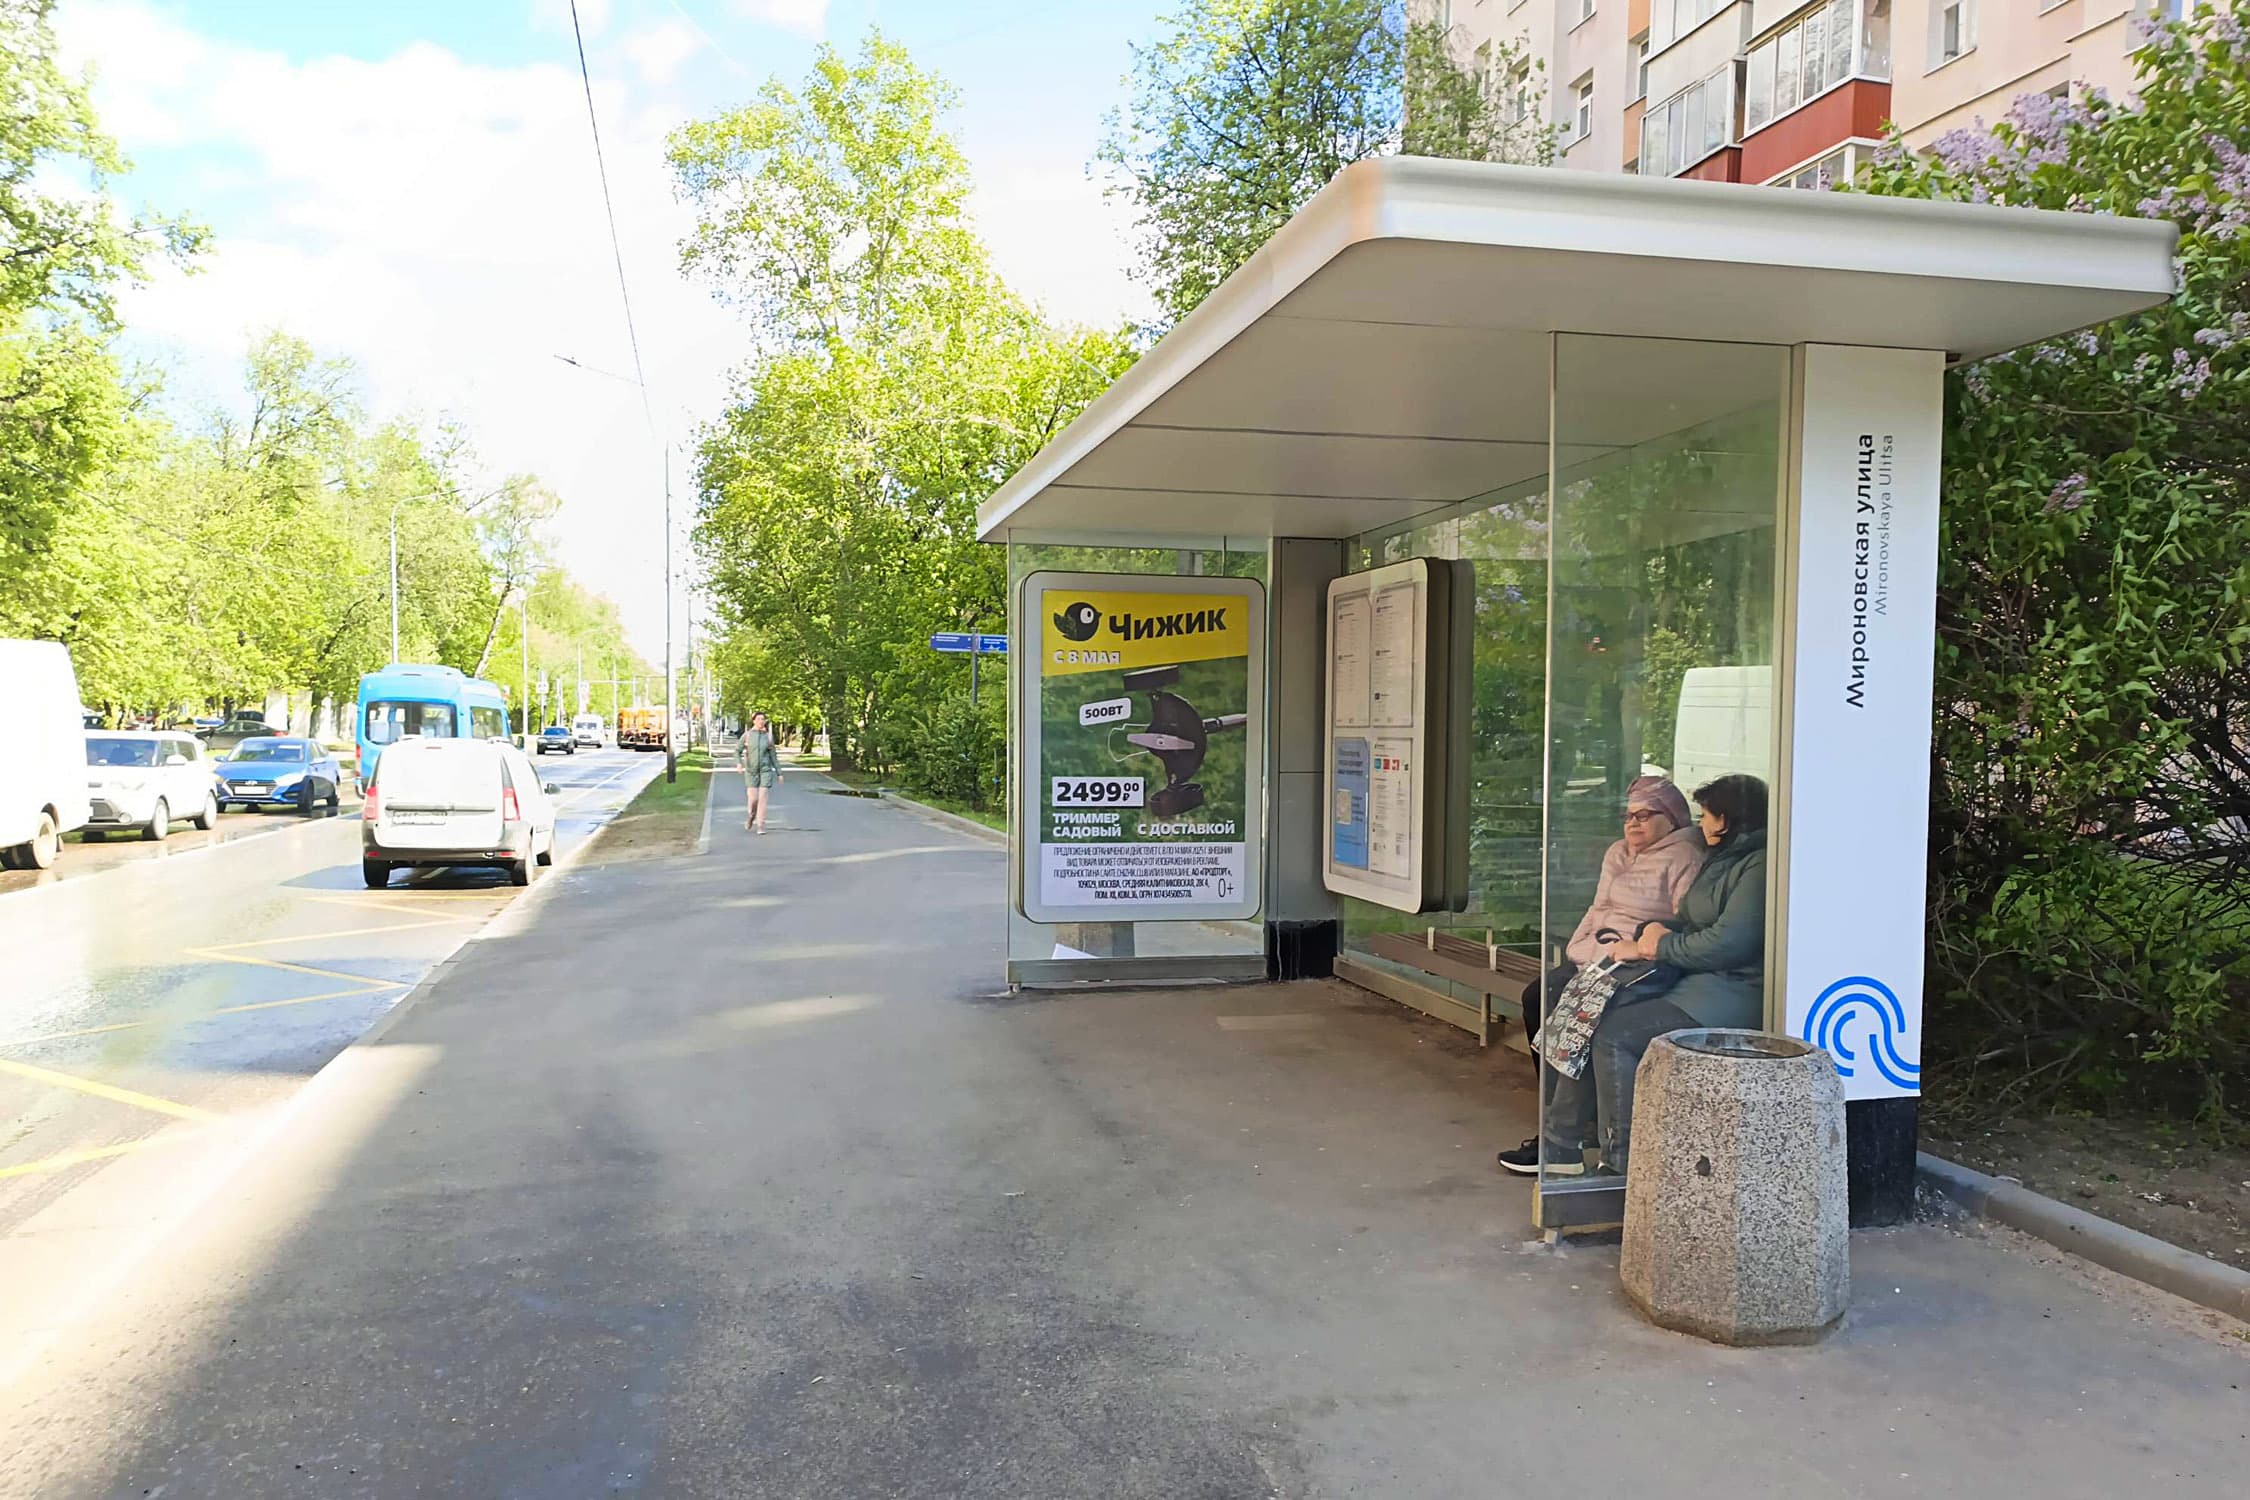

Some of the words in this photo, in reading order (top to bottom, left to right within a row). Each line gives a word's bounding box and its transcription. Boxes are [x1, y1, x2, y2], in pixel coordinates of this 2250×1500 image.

[1878, 435, 1893, 486] Ulitsa
[1856, 434, 1875, 514] улица
[1874, 492, 1893, 615] Mironovskaya
[1846, 522, 1870, 708] Мироновская
[1053, 650, 1064, 664] С
[1068, 651, 1079, 664] 8
[1082, 650, 1120, 665] МАЯ
[1085, 705, 1124, 719] 500ВТ
[1056, 782, 1122, 802] 2499
[1053, 813, 1121, 824] ТРИММЕР
[1137, 824, 1147, 835] С
[1149, 820, 1236, 837] ДОСТАВКОЙ
[1053, 824, 1122, 837] САДОВЫЙ
[1218, 878, 1235, 898] 0+
